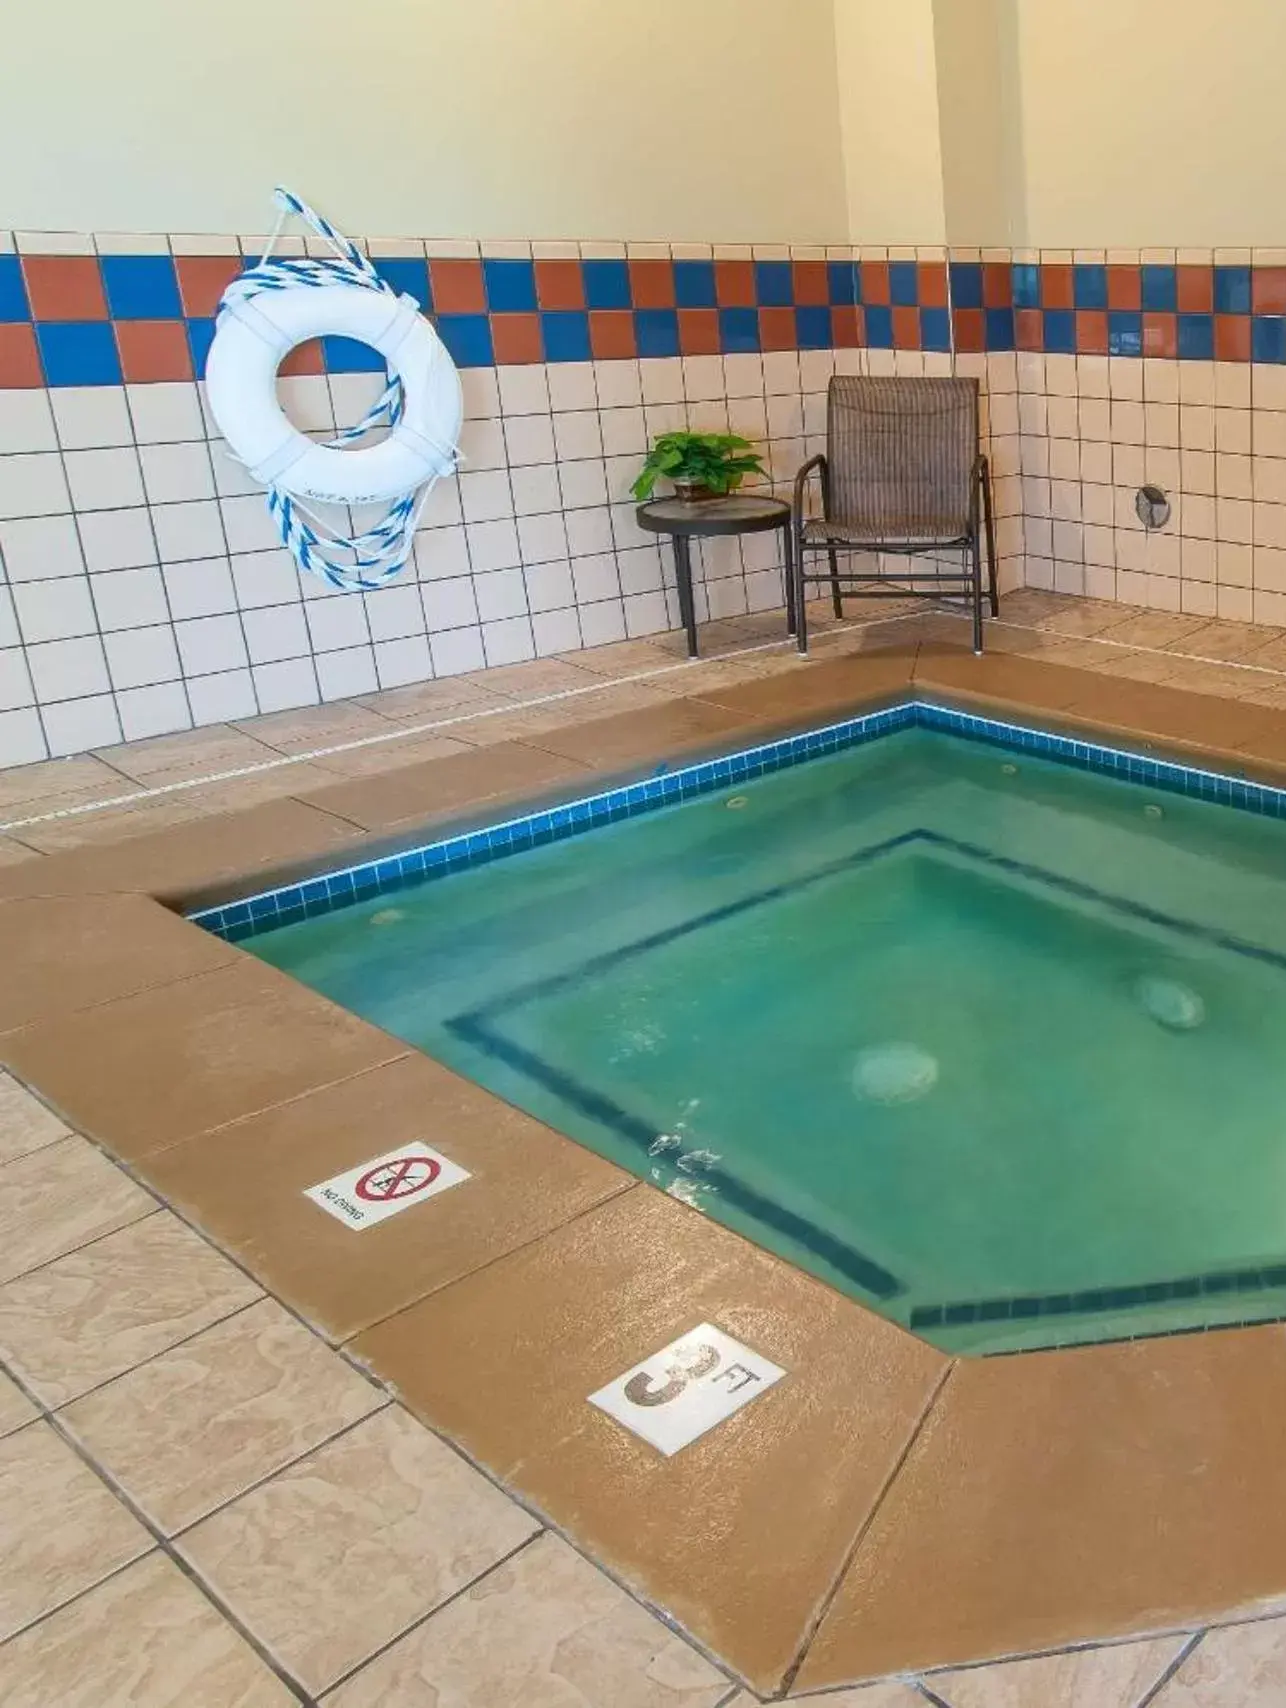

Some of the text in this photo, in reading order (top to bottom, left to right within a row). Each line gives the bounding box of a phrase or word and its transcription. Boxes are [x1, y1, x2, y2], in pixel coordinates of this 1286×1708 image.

[320, 1188, 365, 1221] NO DIVING
[624, 1344, 761, 1407] 3 FT
